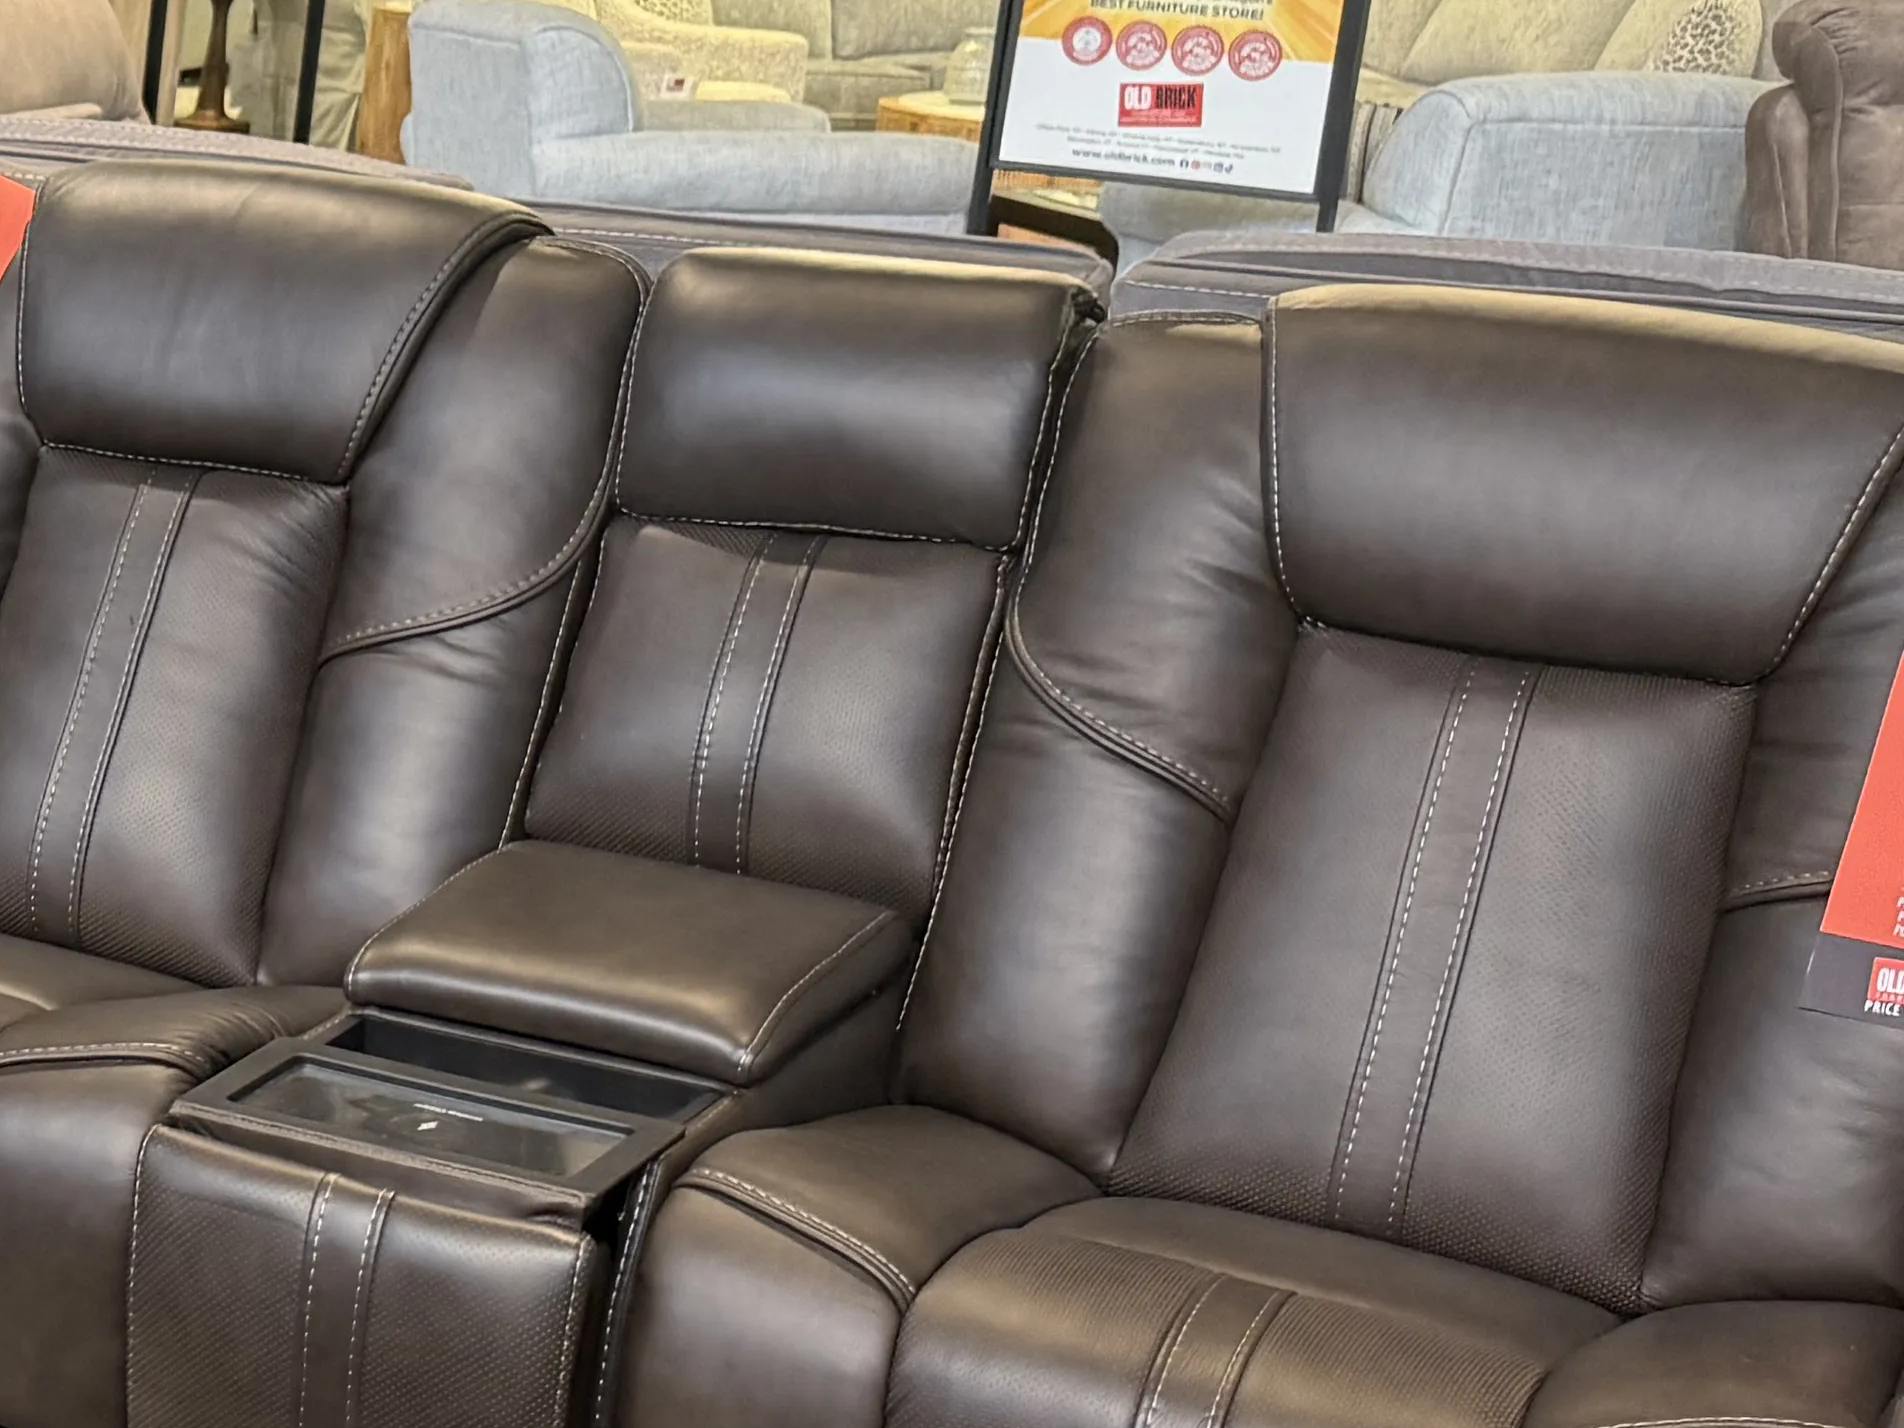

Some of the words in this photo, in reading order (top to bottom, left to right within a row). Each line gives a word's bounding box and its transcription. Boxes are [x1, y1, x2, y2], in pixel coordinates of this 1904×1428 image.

[1212, 4, 1264, 20] STORE!
[1124, 86, 1152, 110] OLD
[1156, 85, 1196, 110] BRICK
[1864, 999, 1901, 1016] PRICE
